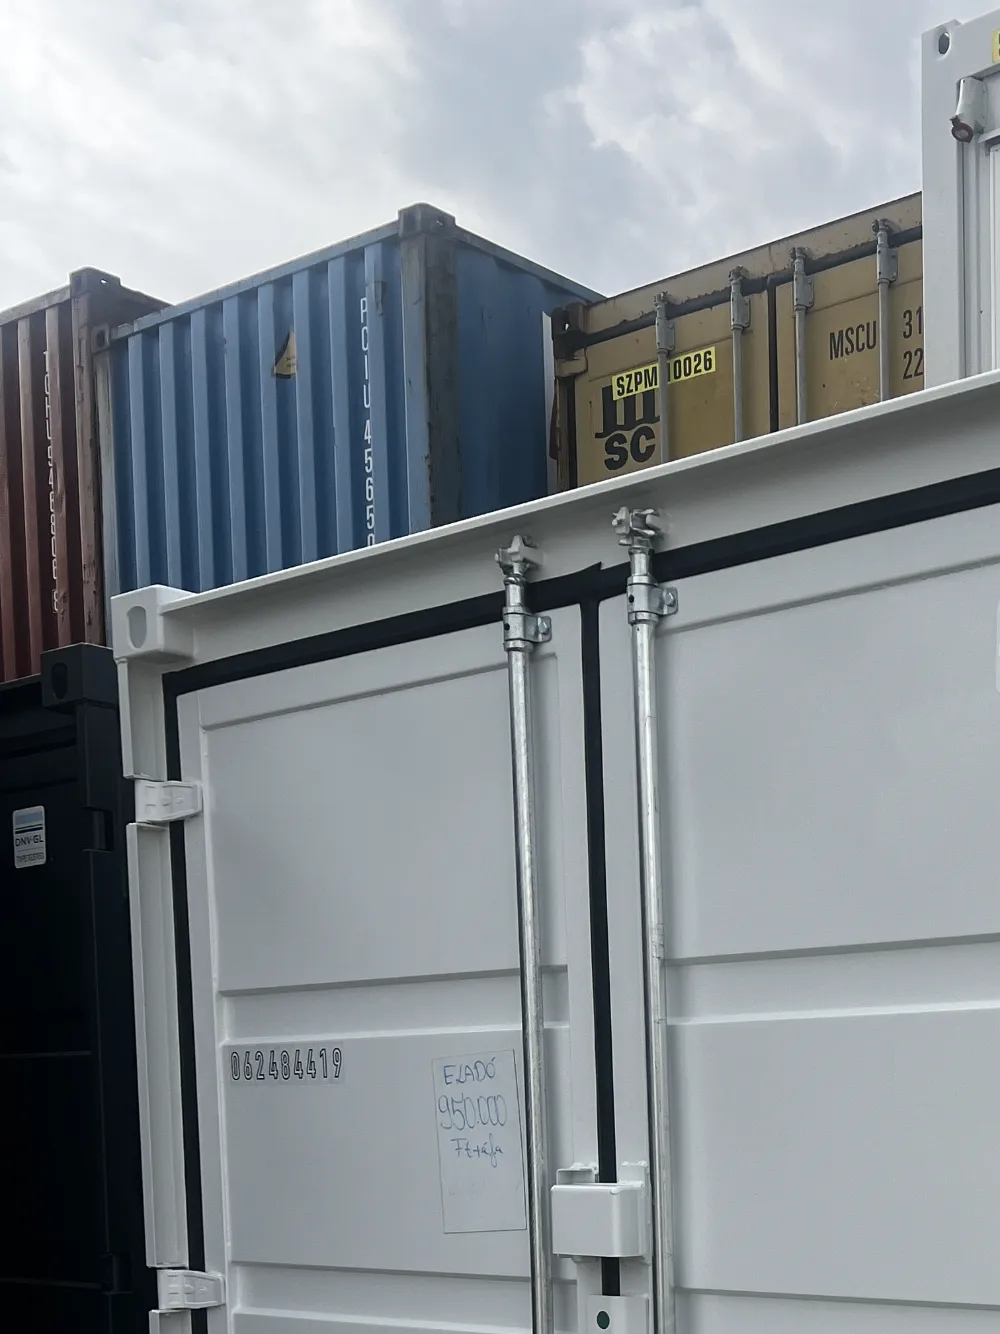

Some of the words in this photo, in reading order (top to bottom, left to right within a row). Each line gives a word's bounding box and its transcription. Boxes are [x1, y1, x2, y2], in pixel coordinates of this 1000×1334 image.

[829, 320, 877, 361] MSCU
[616, 366, 658, 397] SZPM
[231, 1047, 342, 1080] 062484419
[443, 1056, 497, 1085] ELADÓ
